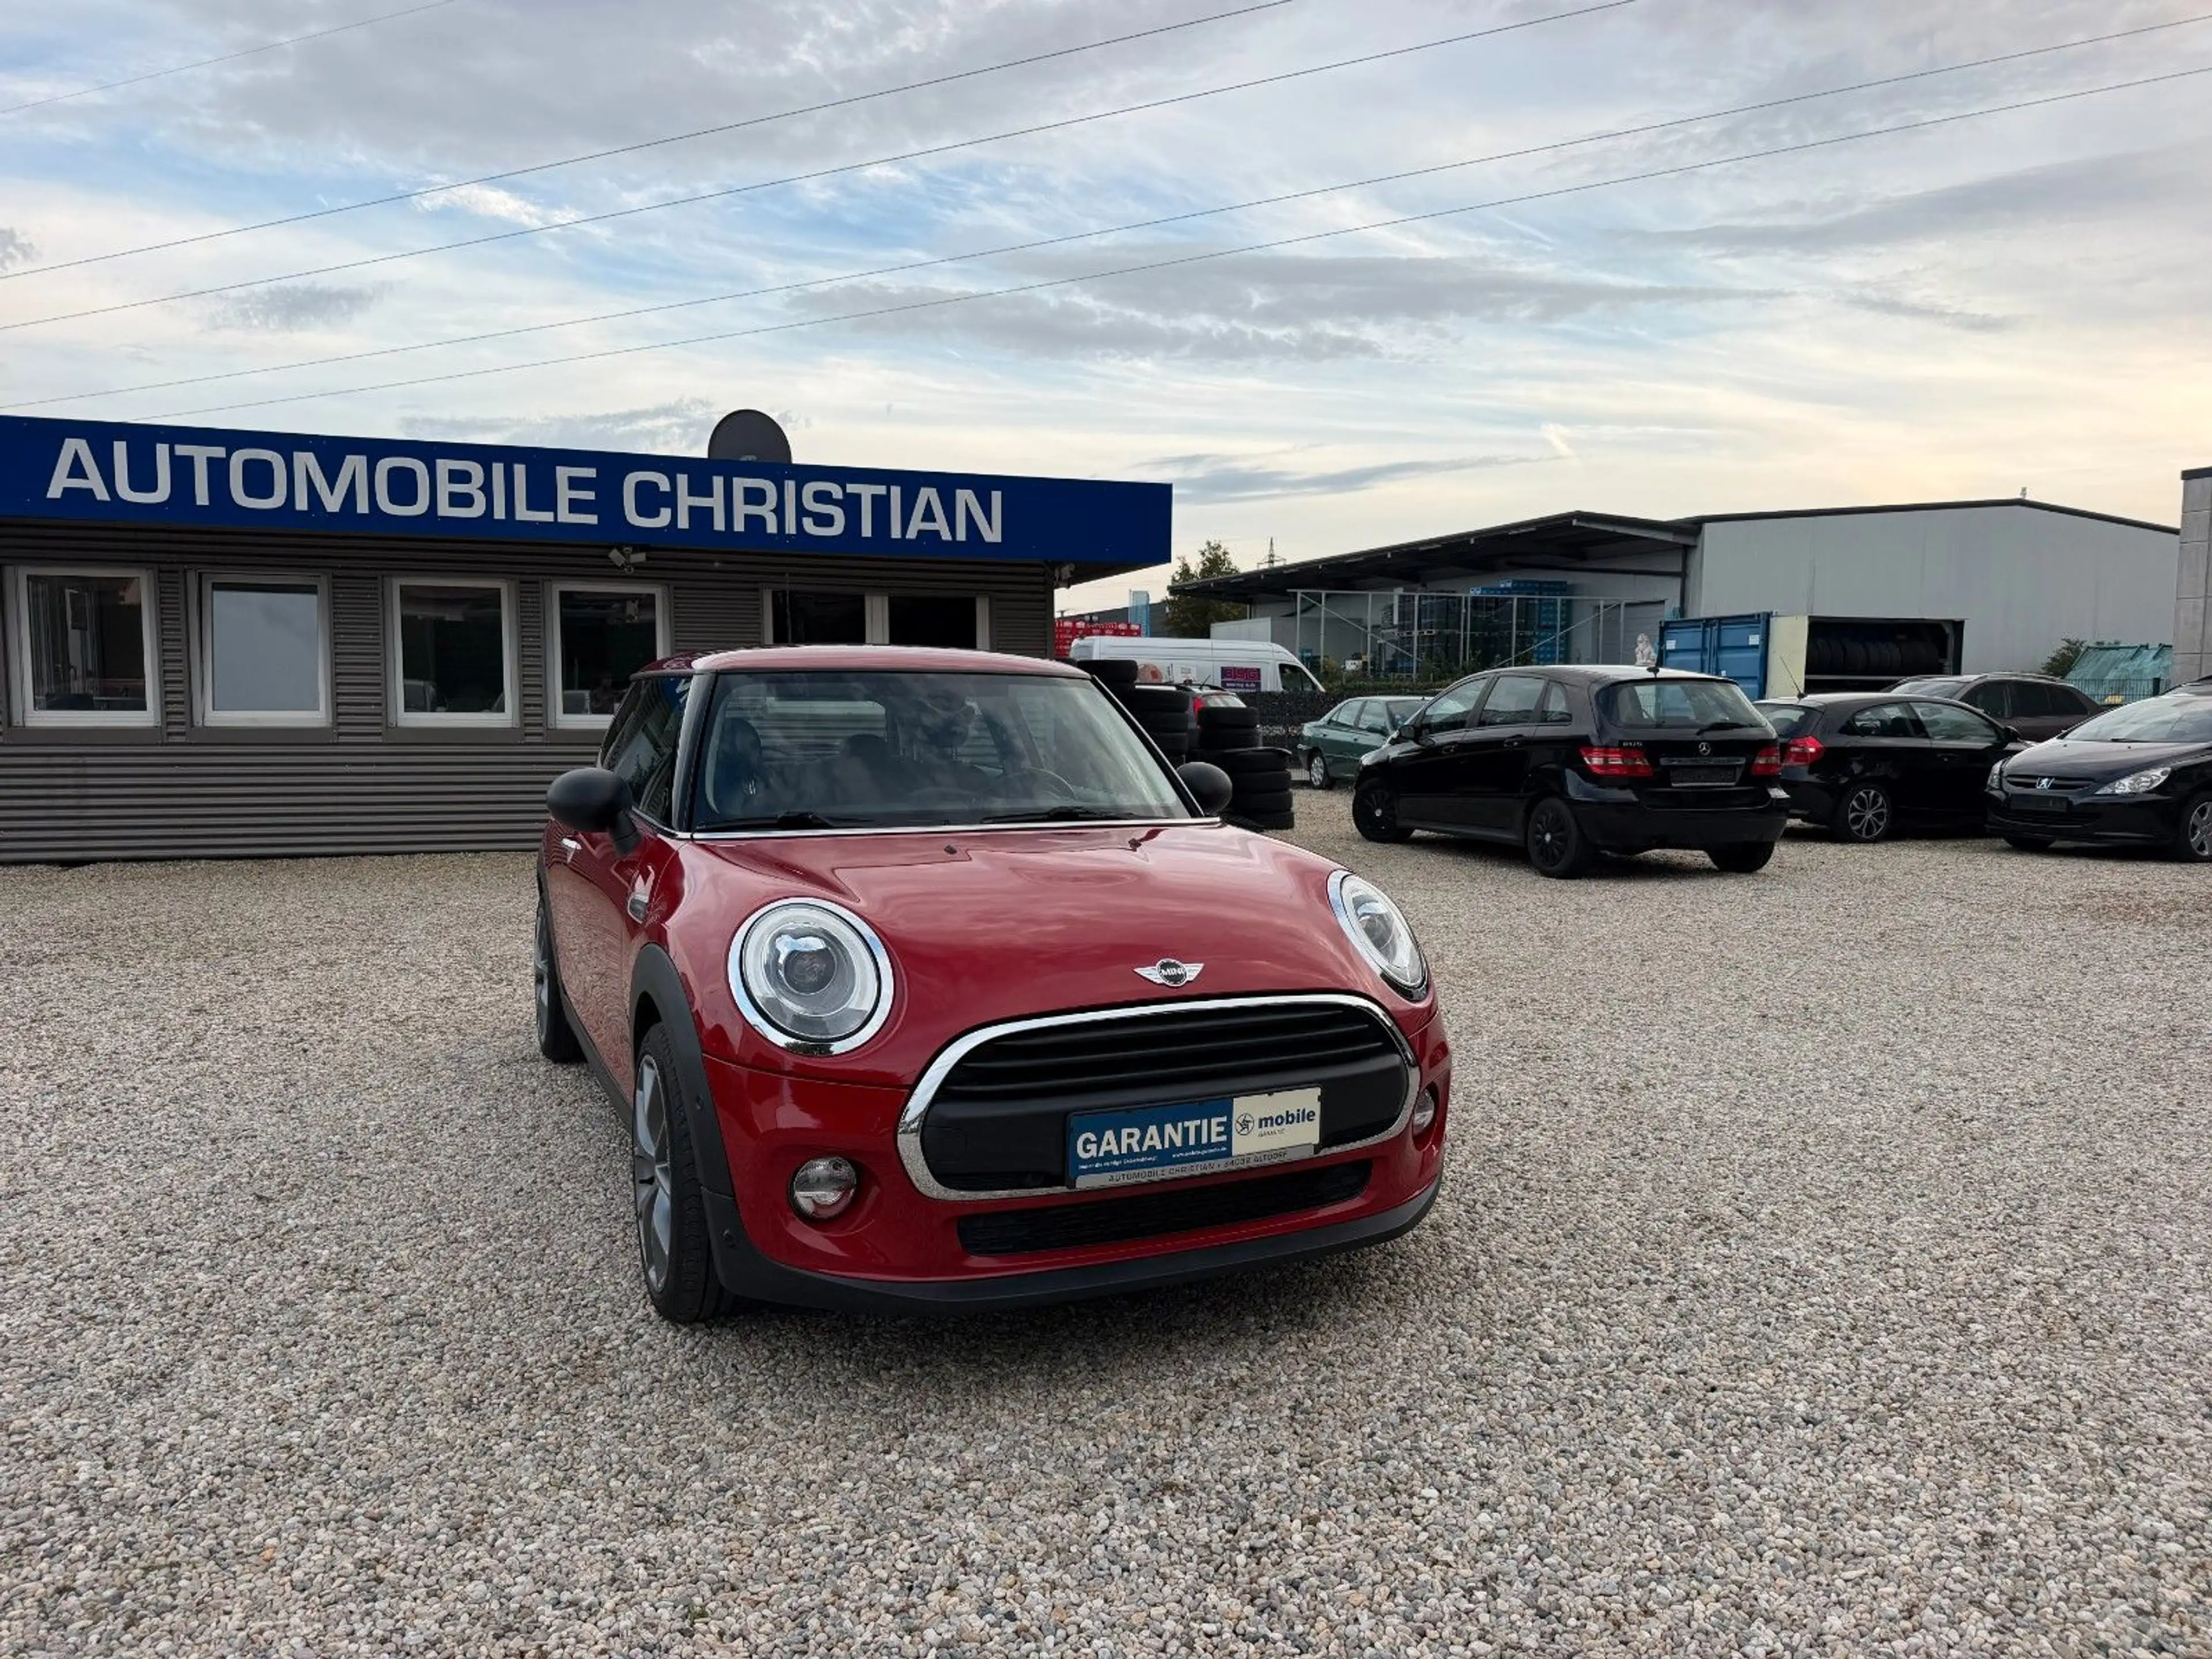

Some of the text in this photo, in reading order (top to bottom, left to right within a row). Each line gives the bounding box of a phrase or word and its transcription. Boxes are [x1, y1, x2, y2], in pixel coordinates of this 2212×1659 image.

[46, 438, 1002, 543] AUTOMOBILE CHRISTIAN
[1077, 1115, 1227, 1159] GARANTIE
[1258, 1108, 1316, 1129] mobile
